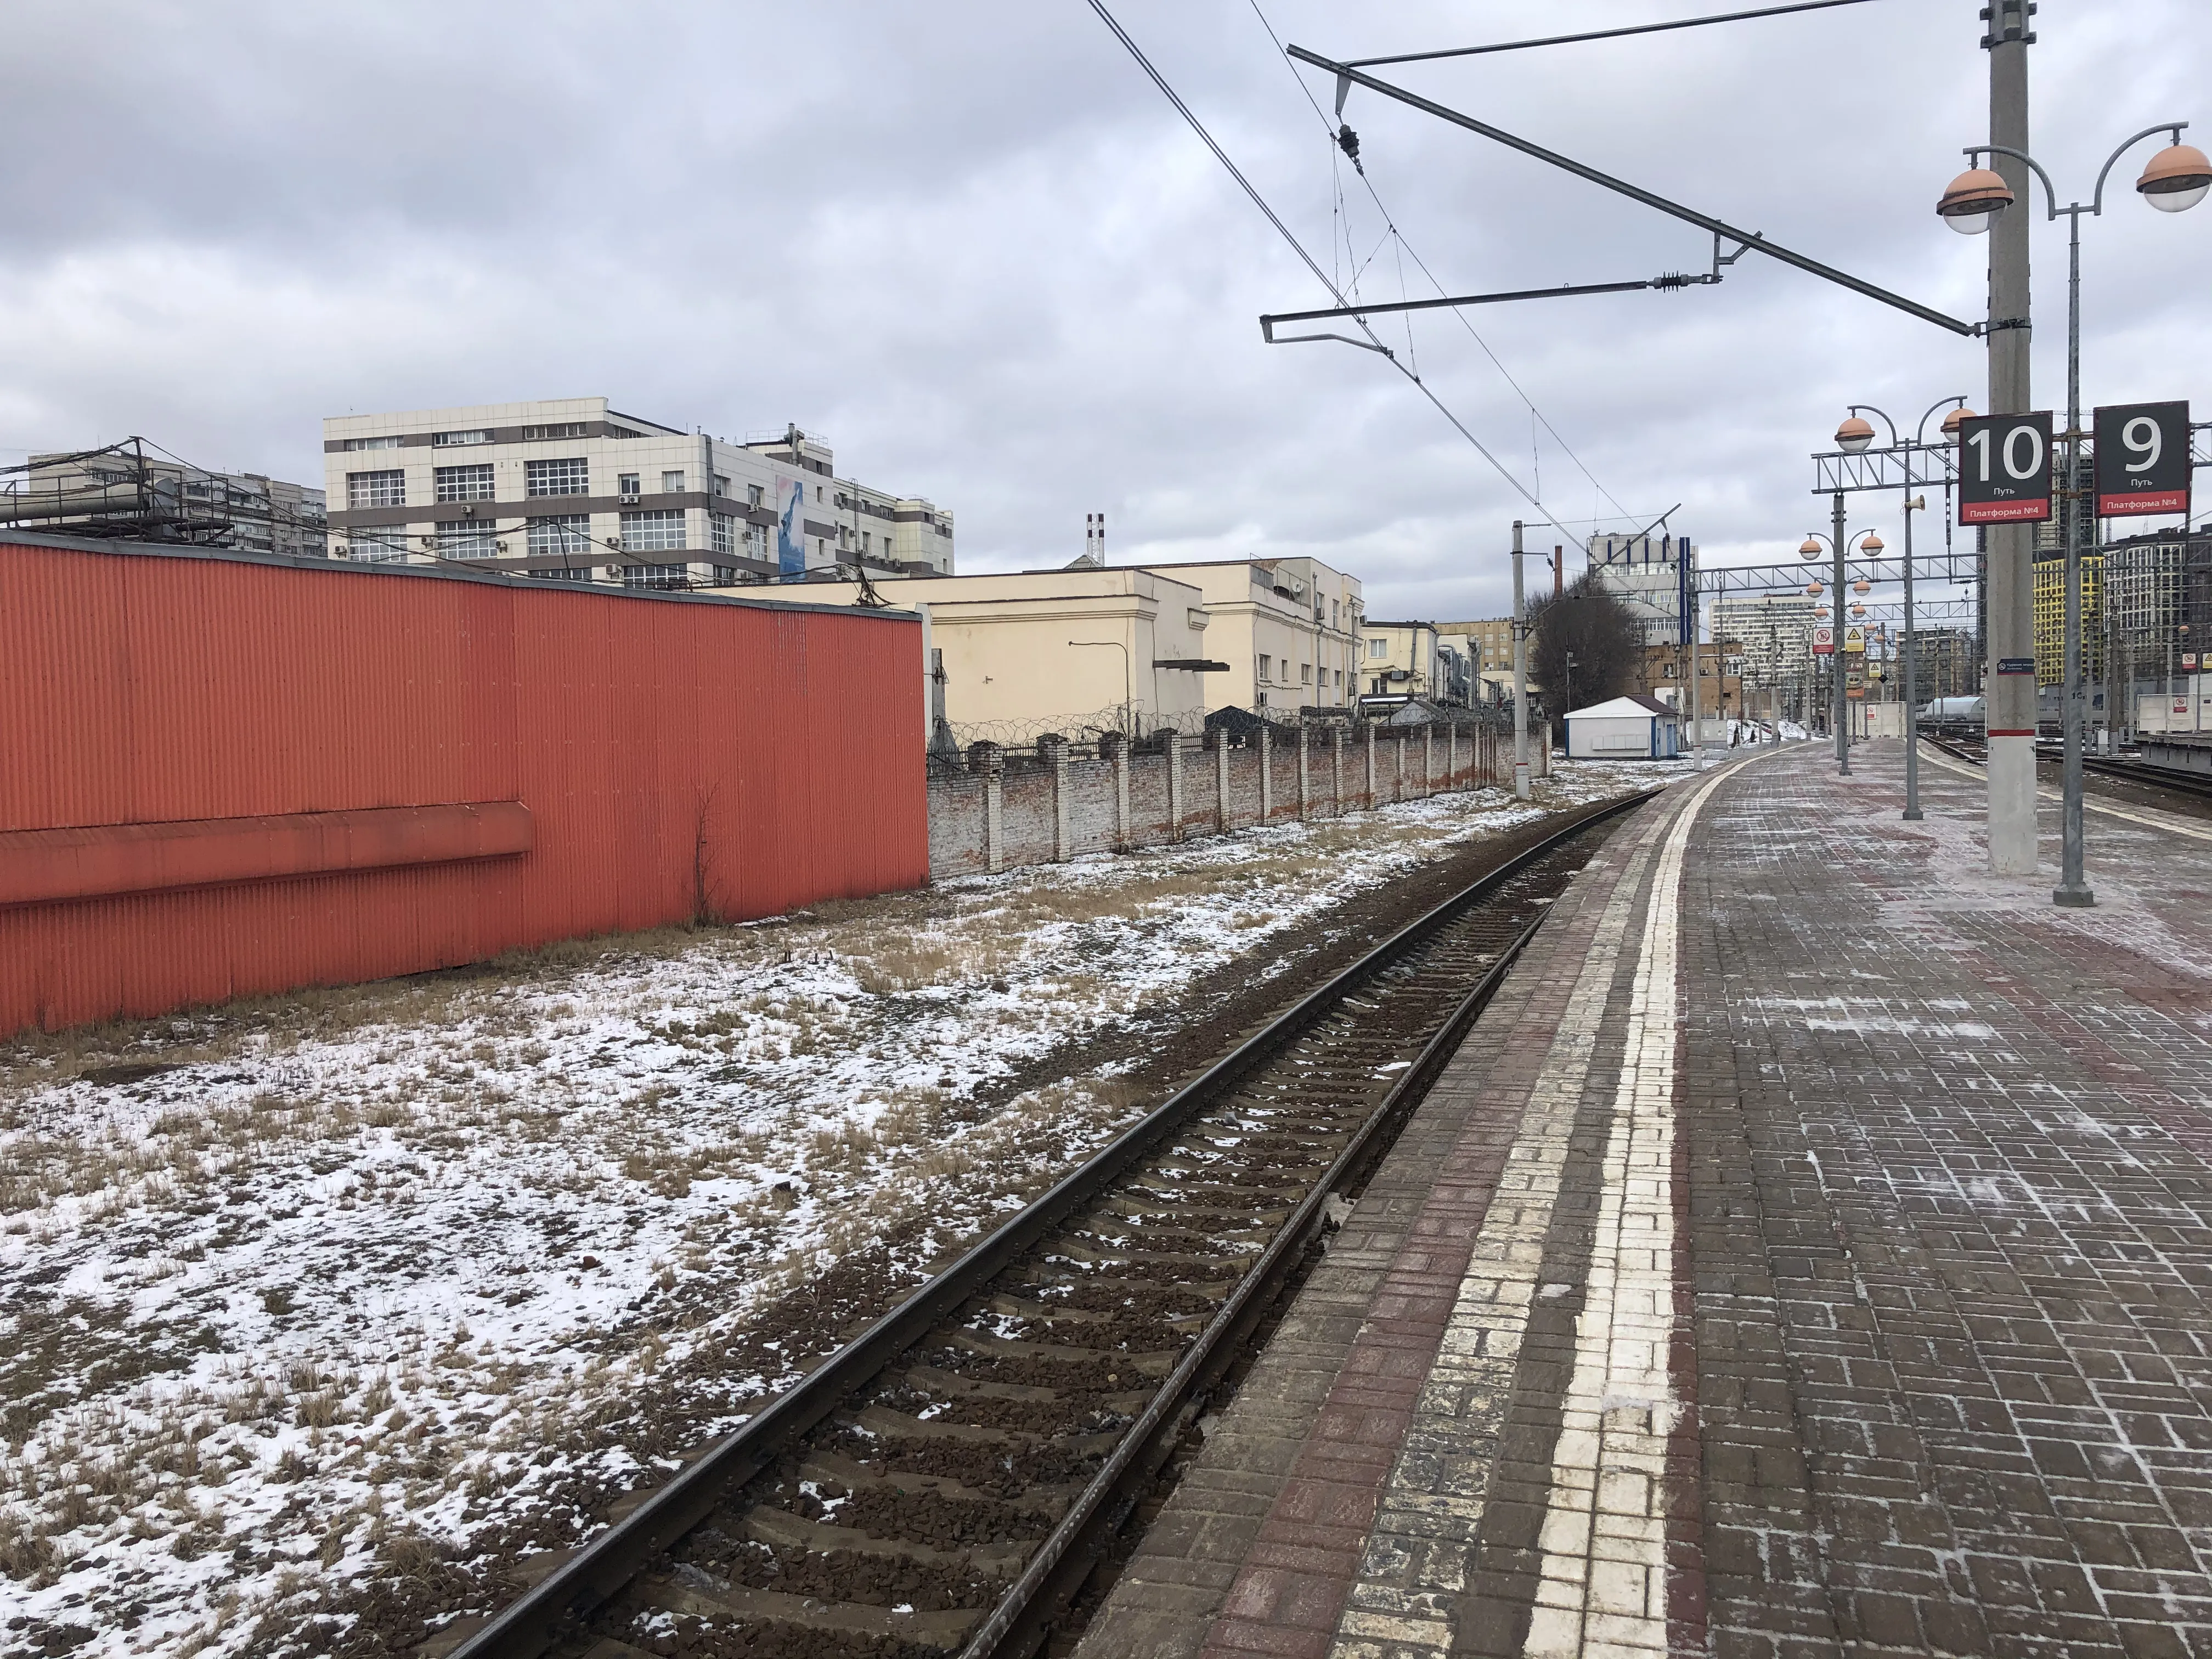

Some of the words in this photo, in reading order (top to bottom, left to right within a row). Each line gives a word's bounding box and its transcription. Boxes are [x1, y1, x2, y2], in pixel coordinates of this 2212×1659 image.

[2122, 416, 2162, 472] 9
[1967, 426, 2043, 481] 10
[2131, 479, 2153, 488] Путь
[1994, 487, 2015, 496] Путь
[2107, 501, 2160, 509] Платформа
[1970, 508, 2022, 517] Платформа
